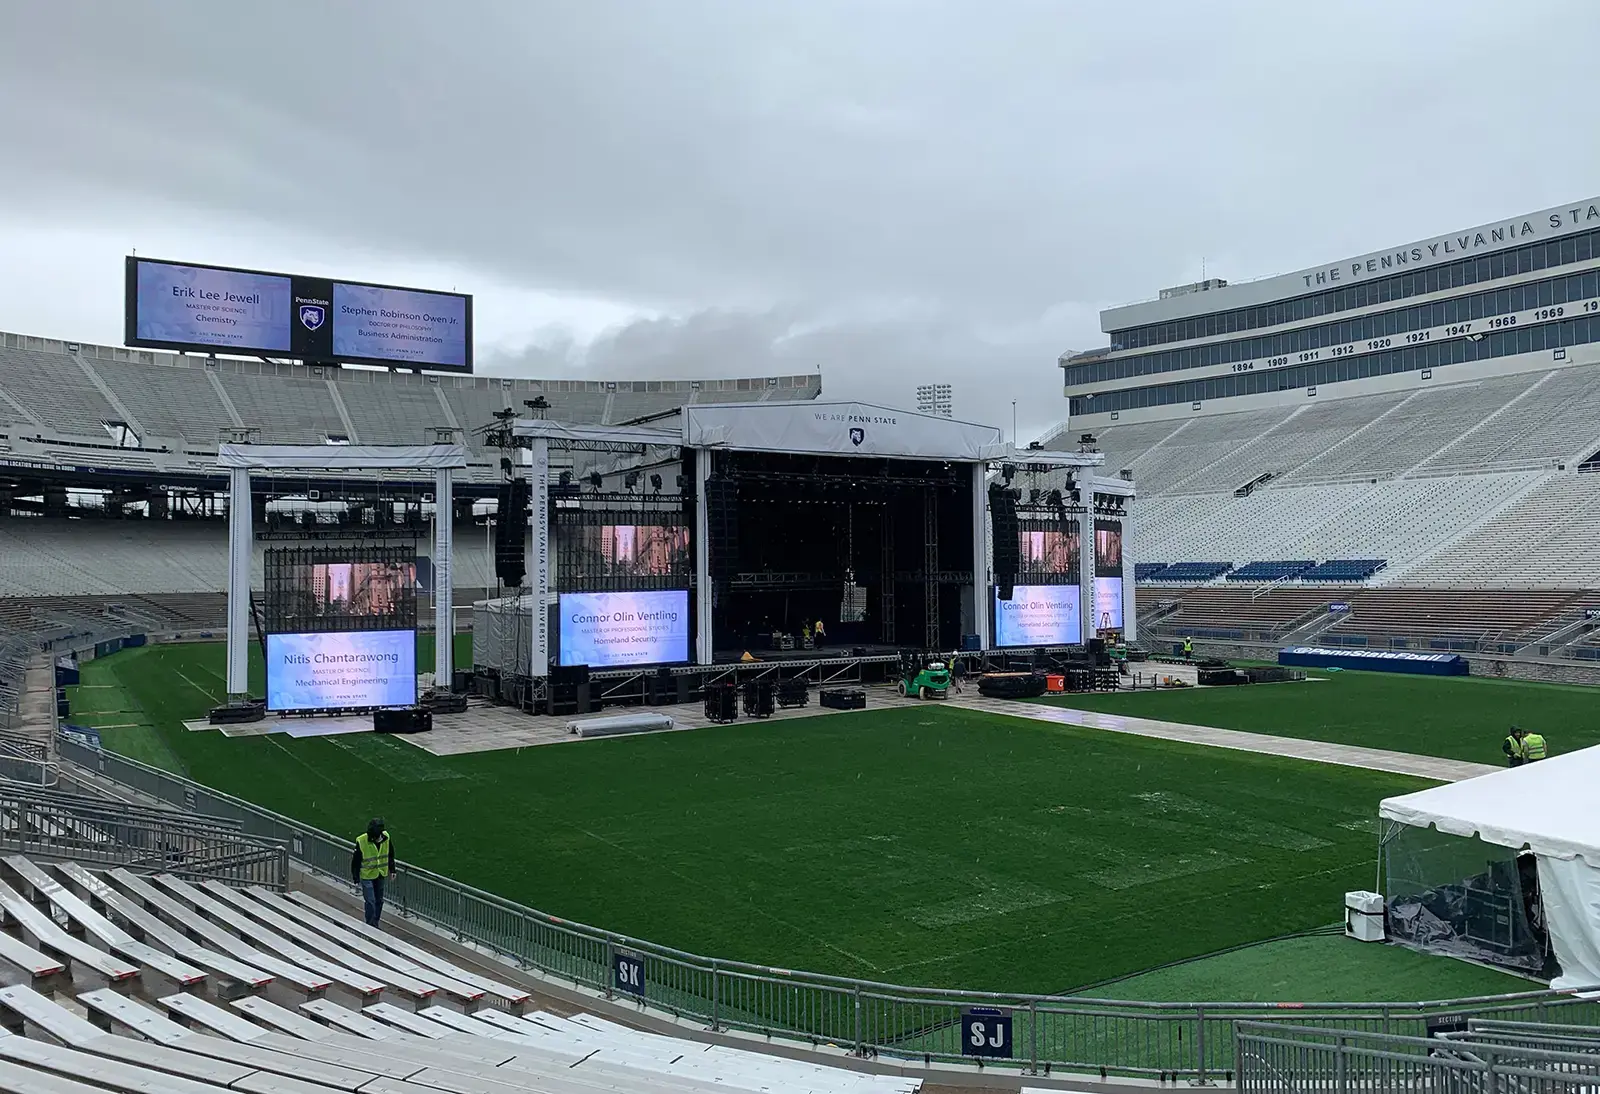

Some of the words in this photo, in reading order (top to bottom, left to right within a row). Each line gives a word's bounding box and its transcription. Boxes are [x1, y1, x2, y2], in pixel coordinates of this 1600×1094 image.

[1303, 268, 1341, 287] THE
[1352, 221, 1534, 276] PENNSYLVANIA
[1549, 205, 1600, 228] STA
[172, 286, 195, 299] Erik
[199, 289, 220, 301] Lee
[223, 291, 260, 304] Jewell
[295, 296, 329, 306] PennState
[186, 303, 212, 311] MASTER
[221, 306, 247, 314] SCIENCE
[195, 314, 238, 326] Chemistry
[341, 305, 378, 317] Stephen
[380, 309, 420, 321] Robinson
[423, 313, 447, 324] Owen
[449, 317, 459, 325] Jr.
[369, 320, 391, 328] DOCTOR
[399, 323, 433, 332] PHILOSOPHY
[358, 329, 389, 339] Business
[391, 332, 443, 344] Administration
[1232, 362, 1254, 373] 1894
[1267, 356, 1288, 367] 1909
[1299, 351, 1320, 362] 1911
[1331, 345, 1354, 356] 1912
[1367, 339, 1391, 350] 1920
[1405, 331, 1430, 343] 1921
[1445, 324, 1472, 336] 1947
[1488, 315, 1517, 328] 1968
[1534, 307, 1564, 320] 1969
[848, 415, 871, 423] PENN
[874, 416, 897, 425] STATE
[1002, 602, 1030, 611] Connor
[1030, 601, 1044, 610] Olin
[1046, 600, 1074, 611] Ventling
[571, 613, 610, 624] Connor
[613, 612, 634, 622] Olin
[637, 610, 678, 622] Ventling
[611, 625, 648, 633] PROFESSIONAL
[593, 636, 630, 645] Homeland
[630, 635, 658, 644] Security
[284, 653, 311, 665] Nitis
[314, 652, 399, 664] Chantarawong
[1293, 647, 1444, 662] @PennStateFball
[295, 678, 340, 687] Mechanical
[341, 677, 389, 687] Engineering
[619, 961, 639, 987] SK
[1438, 1015, 1462, 1024] SECTION
[970, 1021, 1004, 1048] SJ
